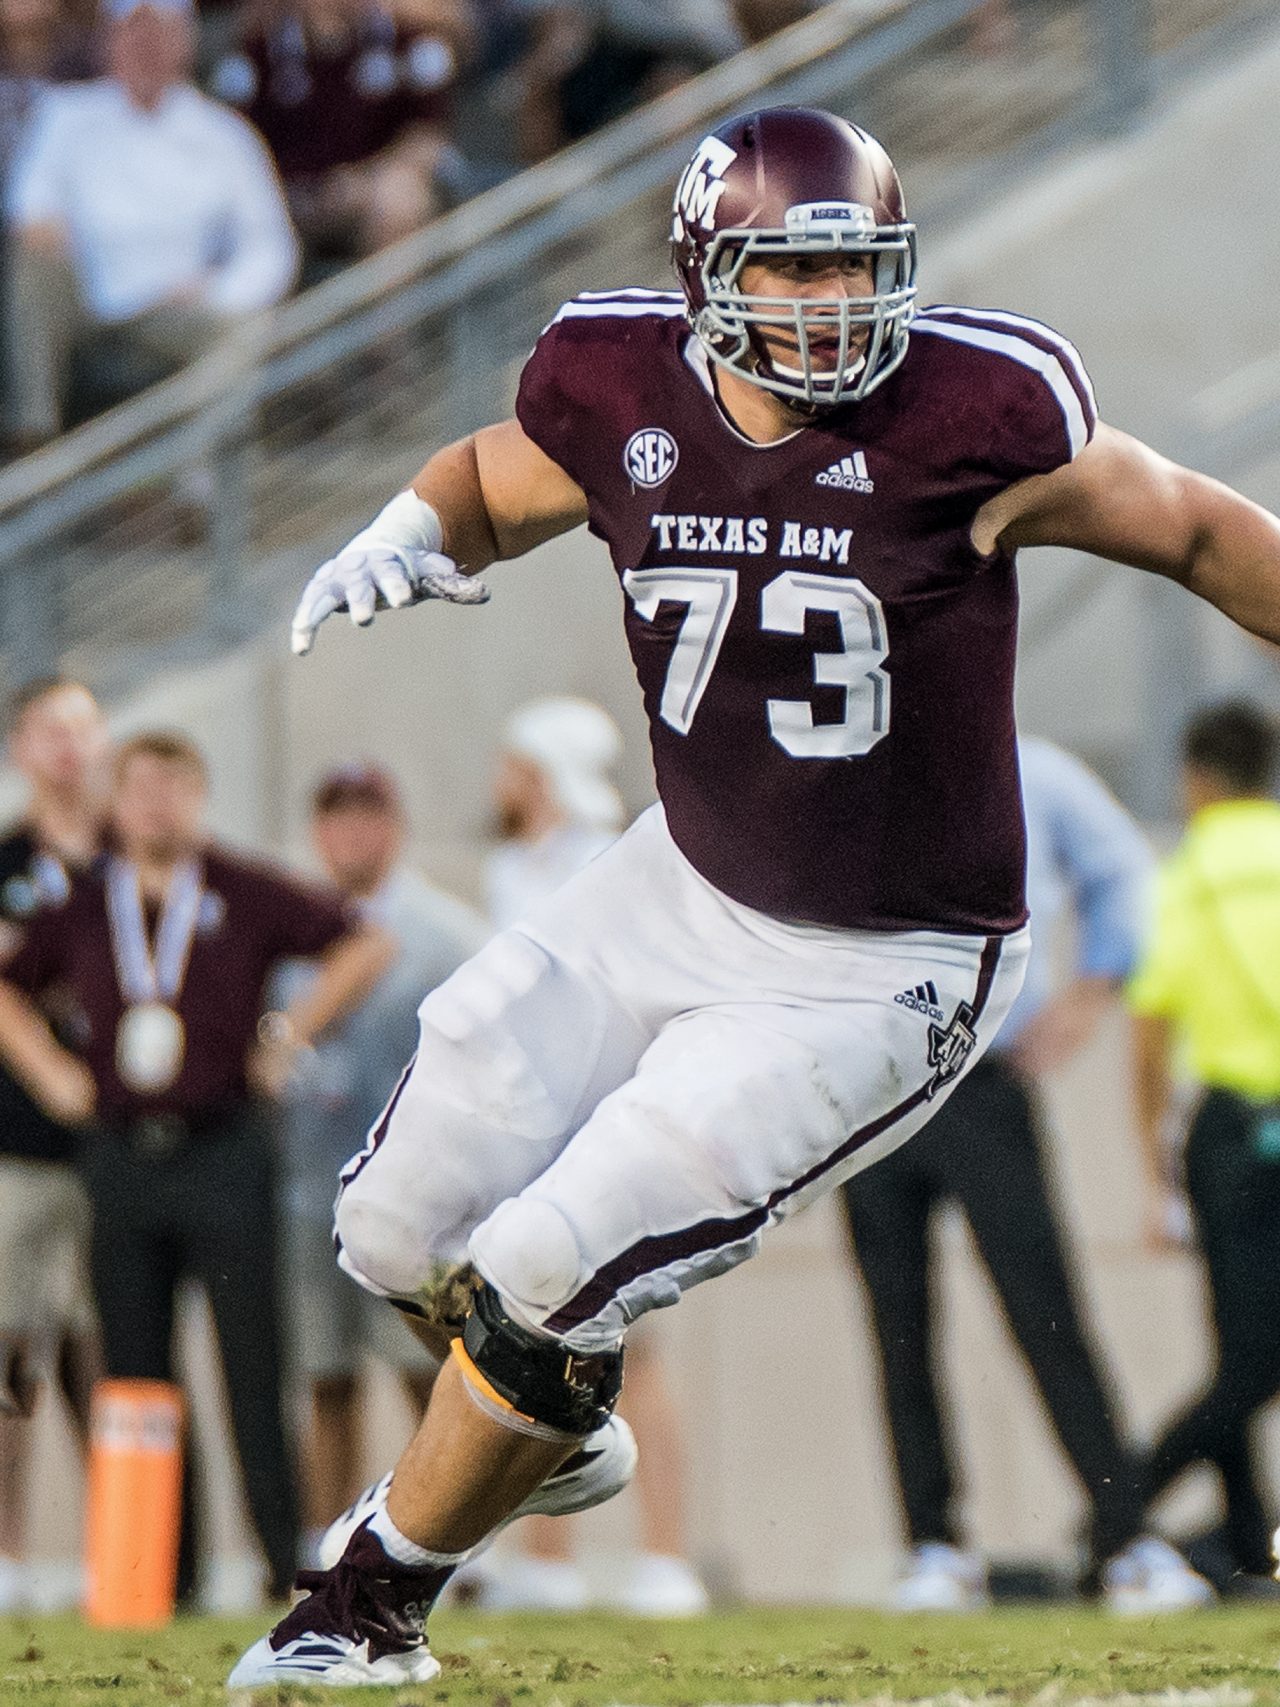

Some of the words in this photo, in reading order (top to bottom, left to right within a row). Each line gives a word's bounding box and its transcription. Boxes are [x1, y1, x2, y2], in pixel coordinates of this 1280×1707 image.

[629, 433, 674, 483] SEC
[816, 472, 875, 494] adidas
[651, 514, 768, 555] TEXAS
[779, 521, 853, 565] A&M
[622, 567, 892, 759] 73
[894, 994, 945, 1021] adidas
